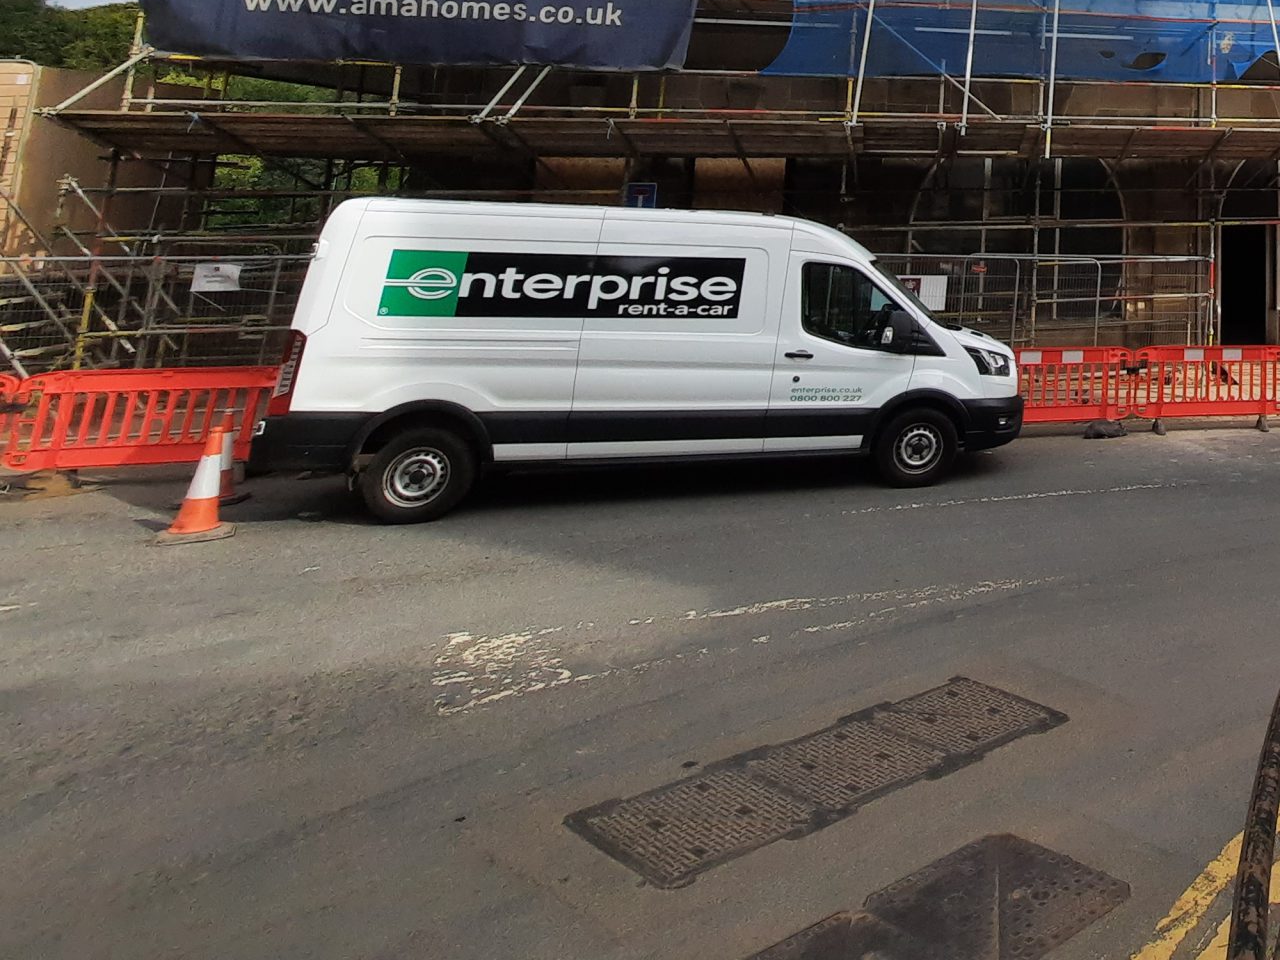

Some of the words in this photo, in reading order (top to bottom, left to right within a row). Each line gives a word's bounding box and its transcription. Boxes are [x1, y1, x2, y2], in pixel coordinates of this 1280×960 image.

[385, 266, 738, 310] enterprise
[617, 302, 733, 317] rent-a-car
[790, 386, 863, 394] enterprise.co.uk
[790, 394, 818, 402] 0800
[820, 394, 840, 402] 800
[842, 394, 862, 402] 227
